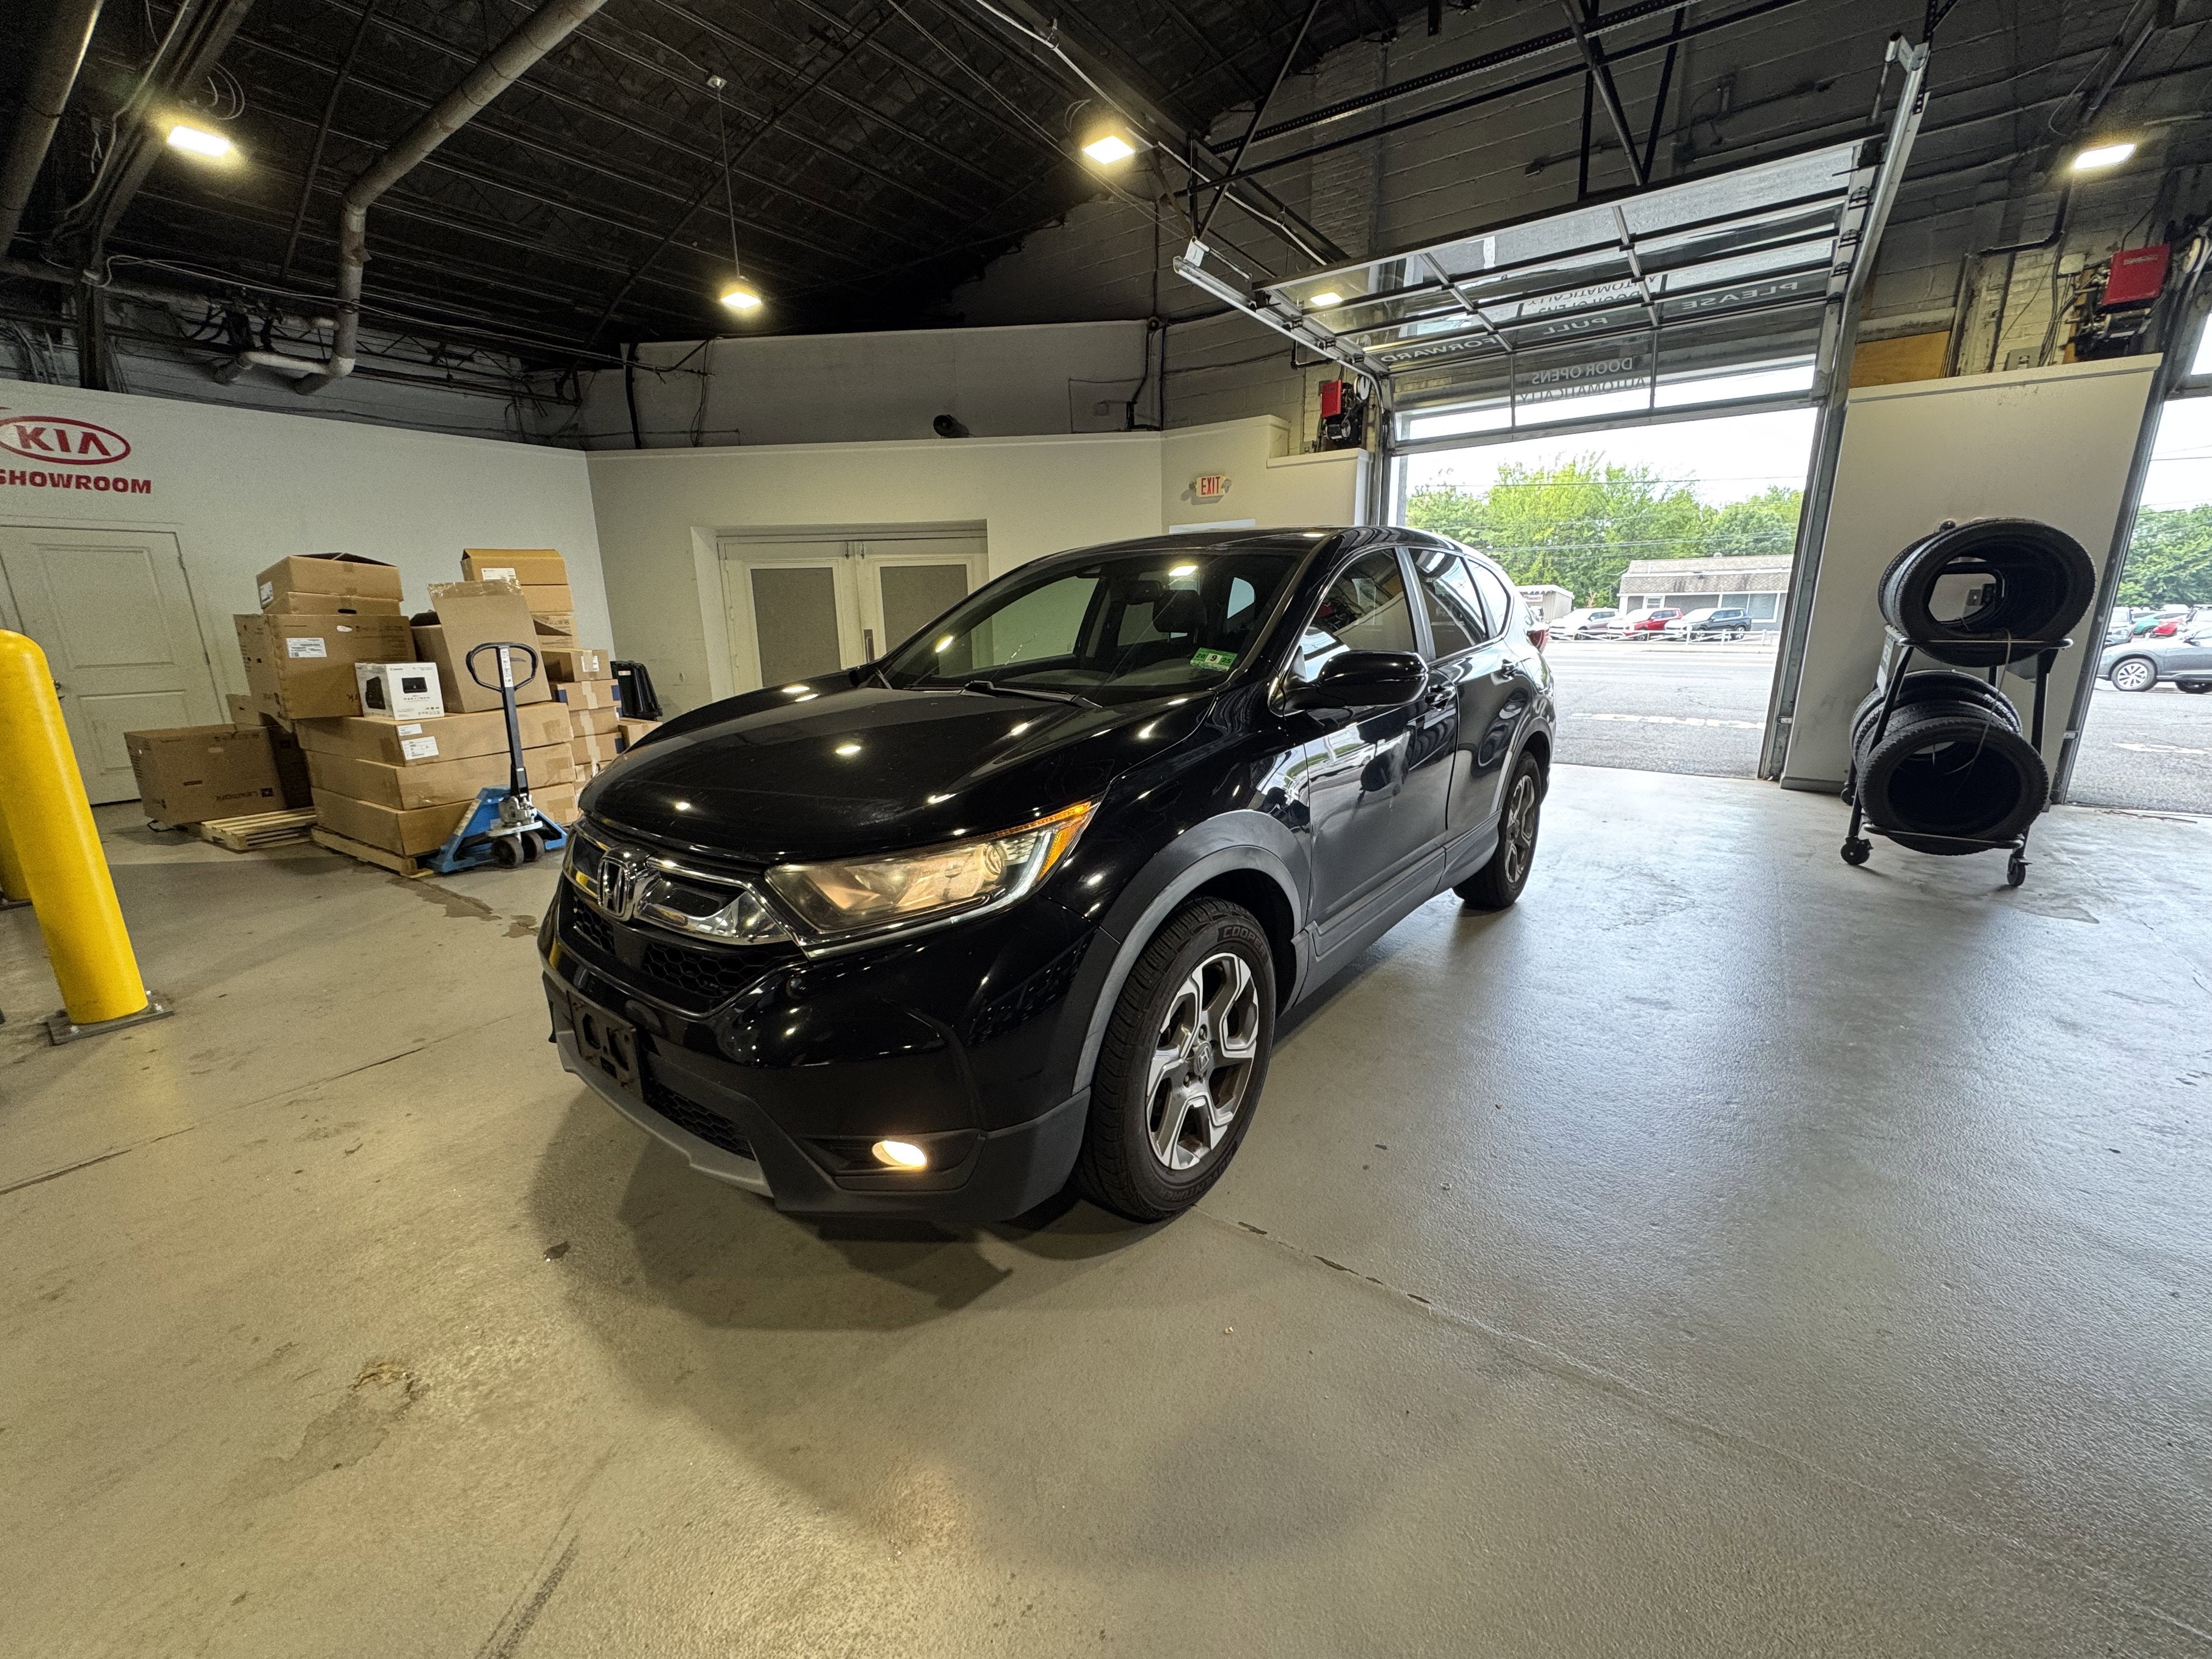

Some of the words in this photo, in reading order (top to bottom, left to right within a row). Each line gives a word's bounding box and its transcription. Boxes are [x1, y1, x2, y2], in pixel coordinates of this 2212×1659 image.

[14, 425, 112, 457] KIA
[1201, 476, 1221, 495] EXIT
[1223, 926, 1267, 957] COOPER
